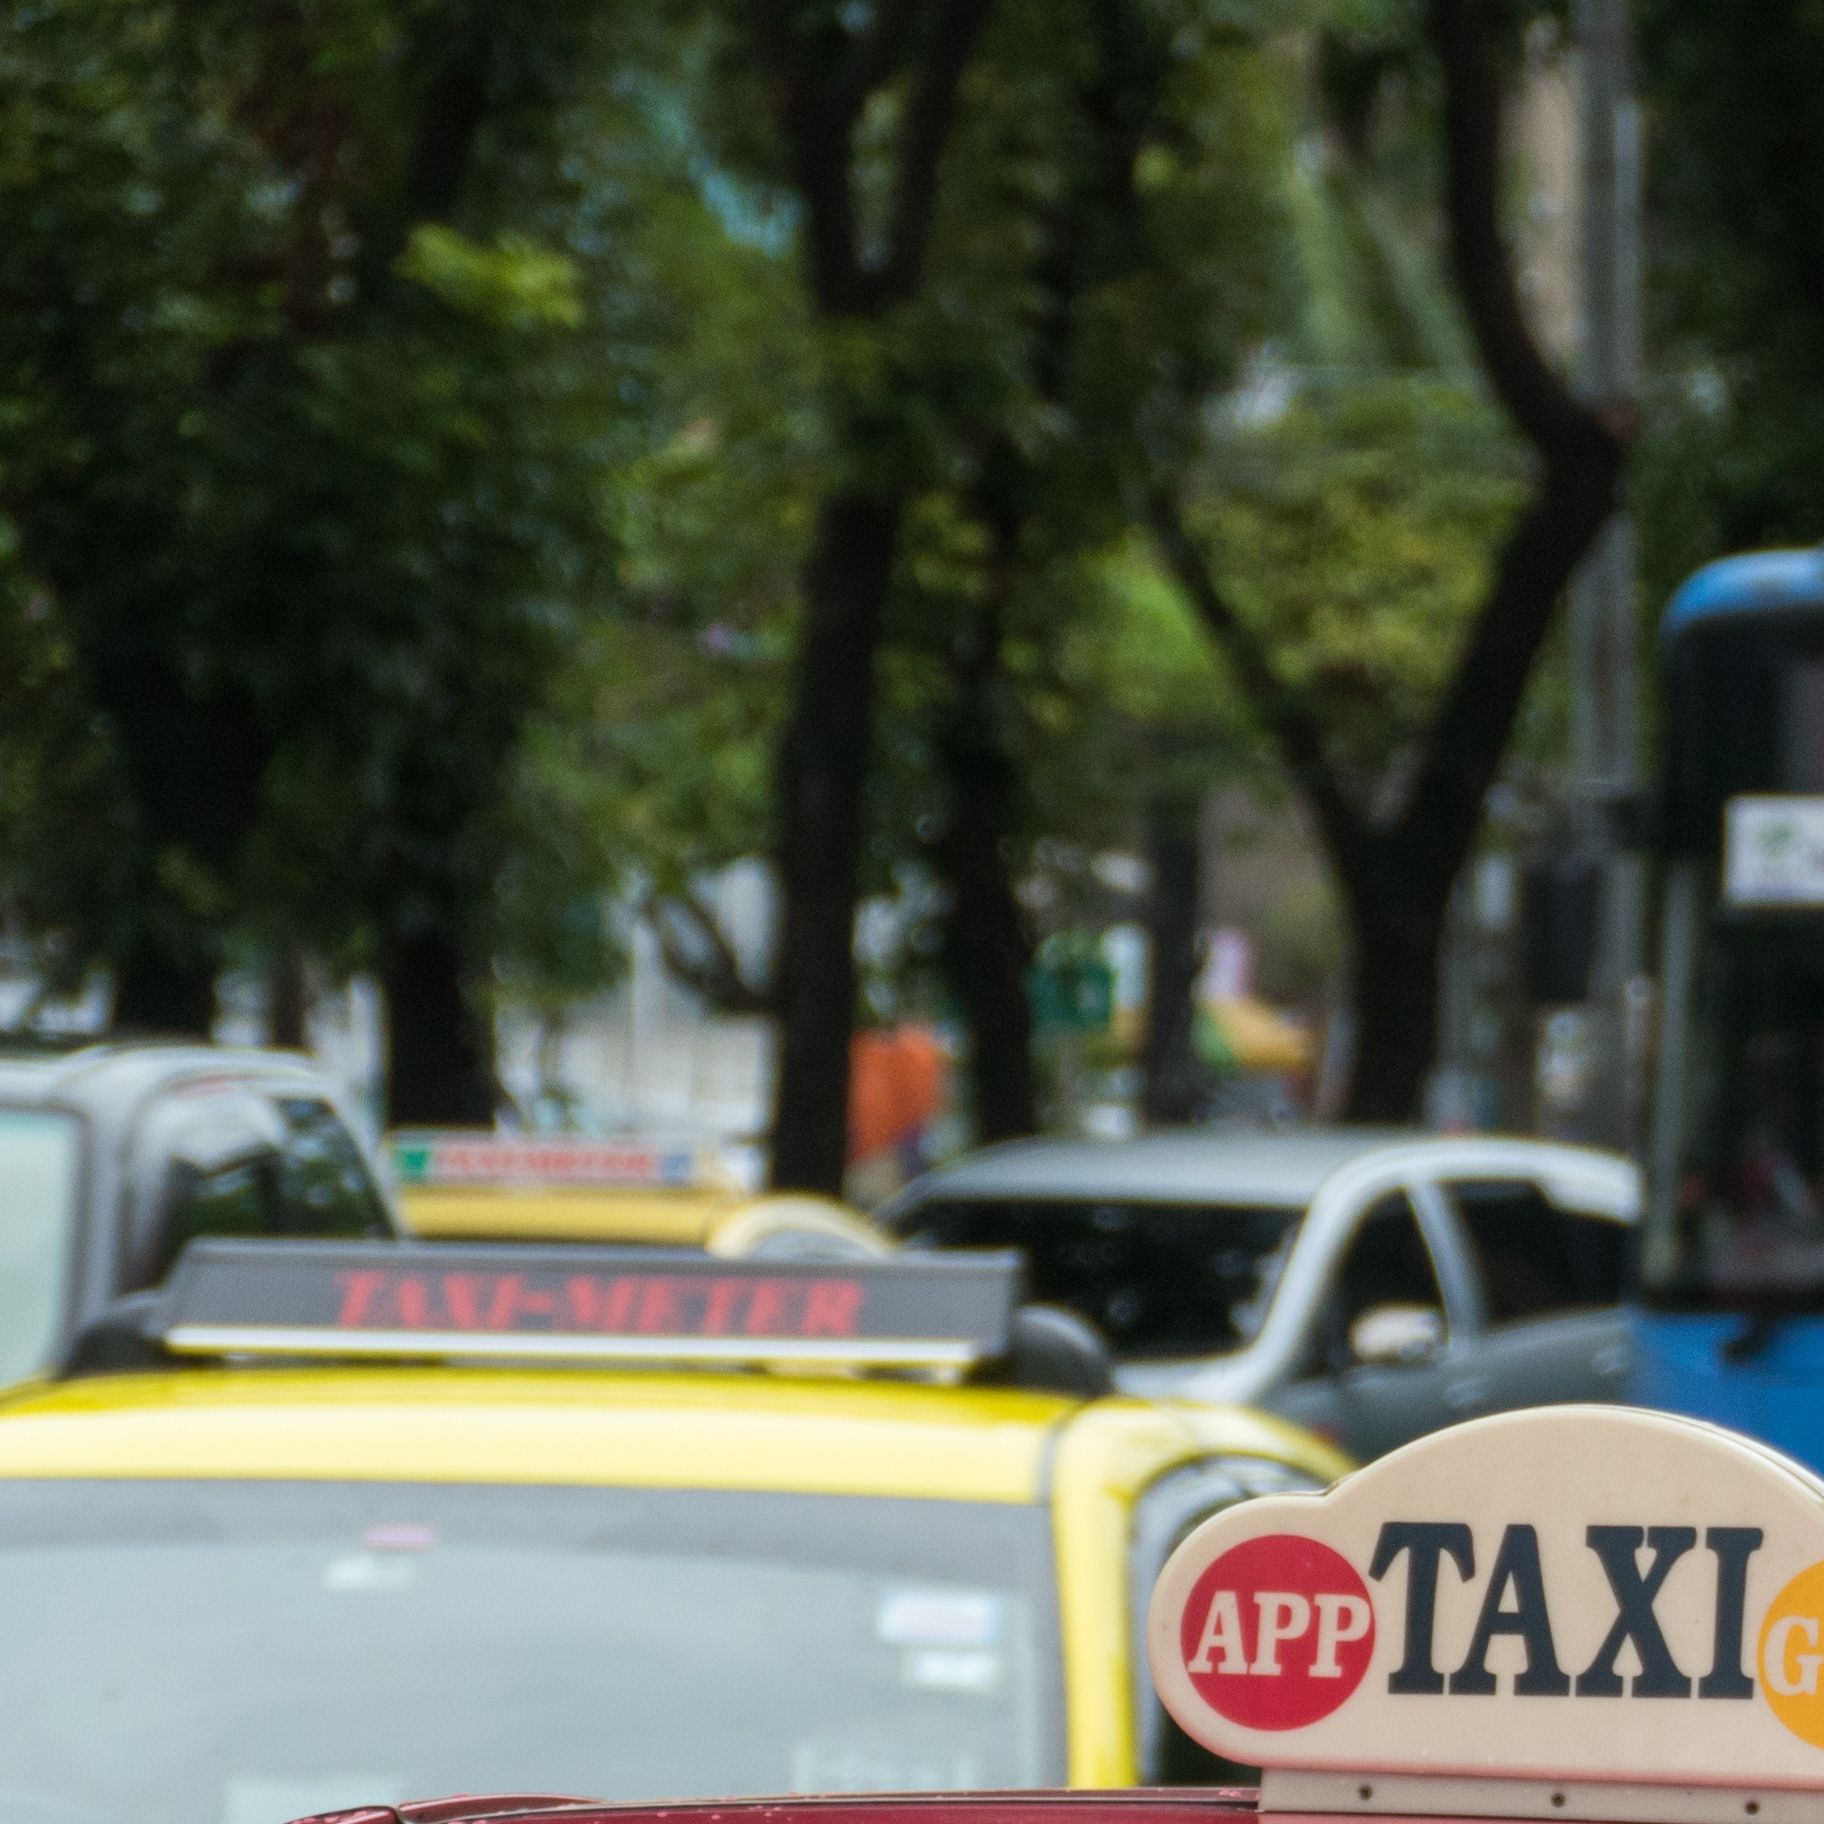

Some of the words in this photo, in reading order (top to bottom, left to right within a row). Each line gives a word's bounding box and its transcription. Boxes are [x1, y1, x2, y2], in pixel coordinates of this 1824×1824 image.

[332, 1267, 864, 1339] TAXI-METER
[1188, 1590, 1372, 1678] APP
[1369, 1522, 1764, 1700] TAXI
